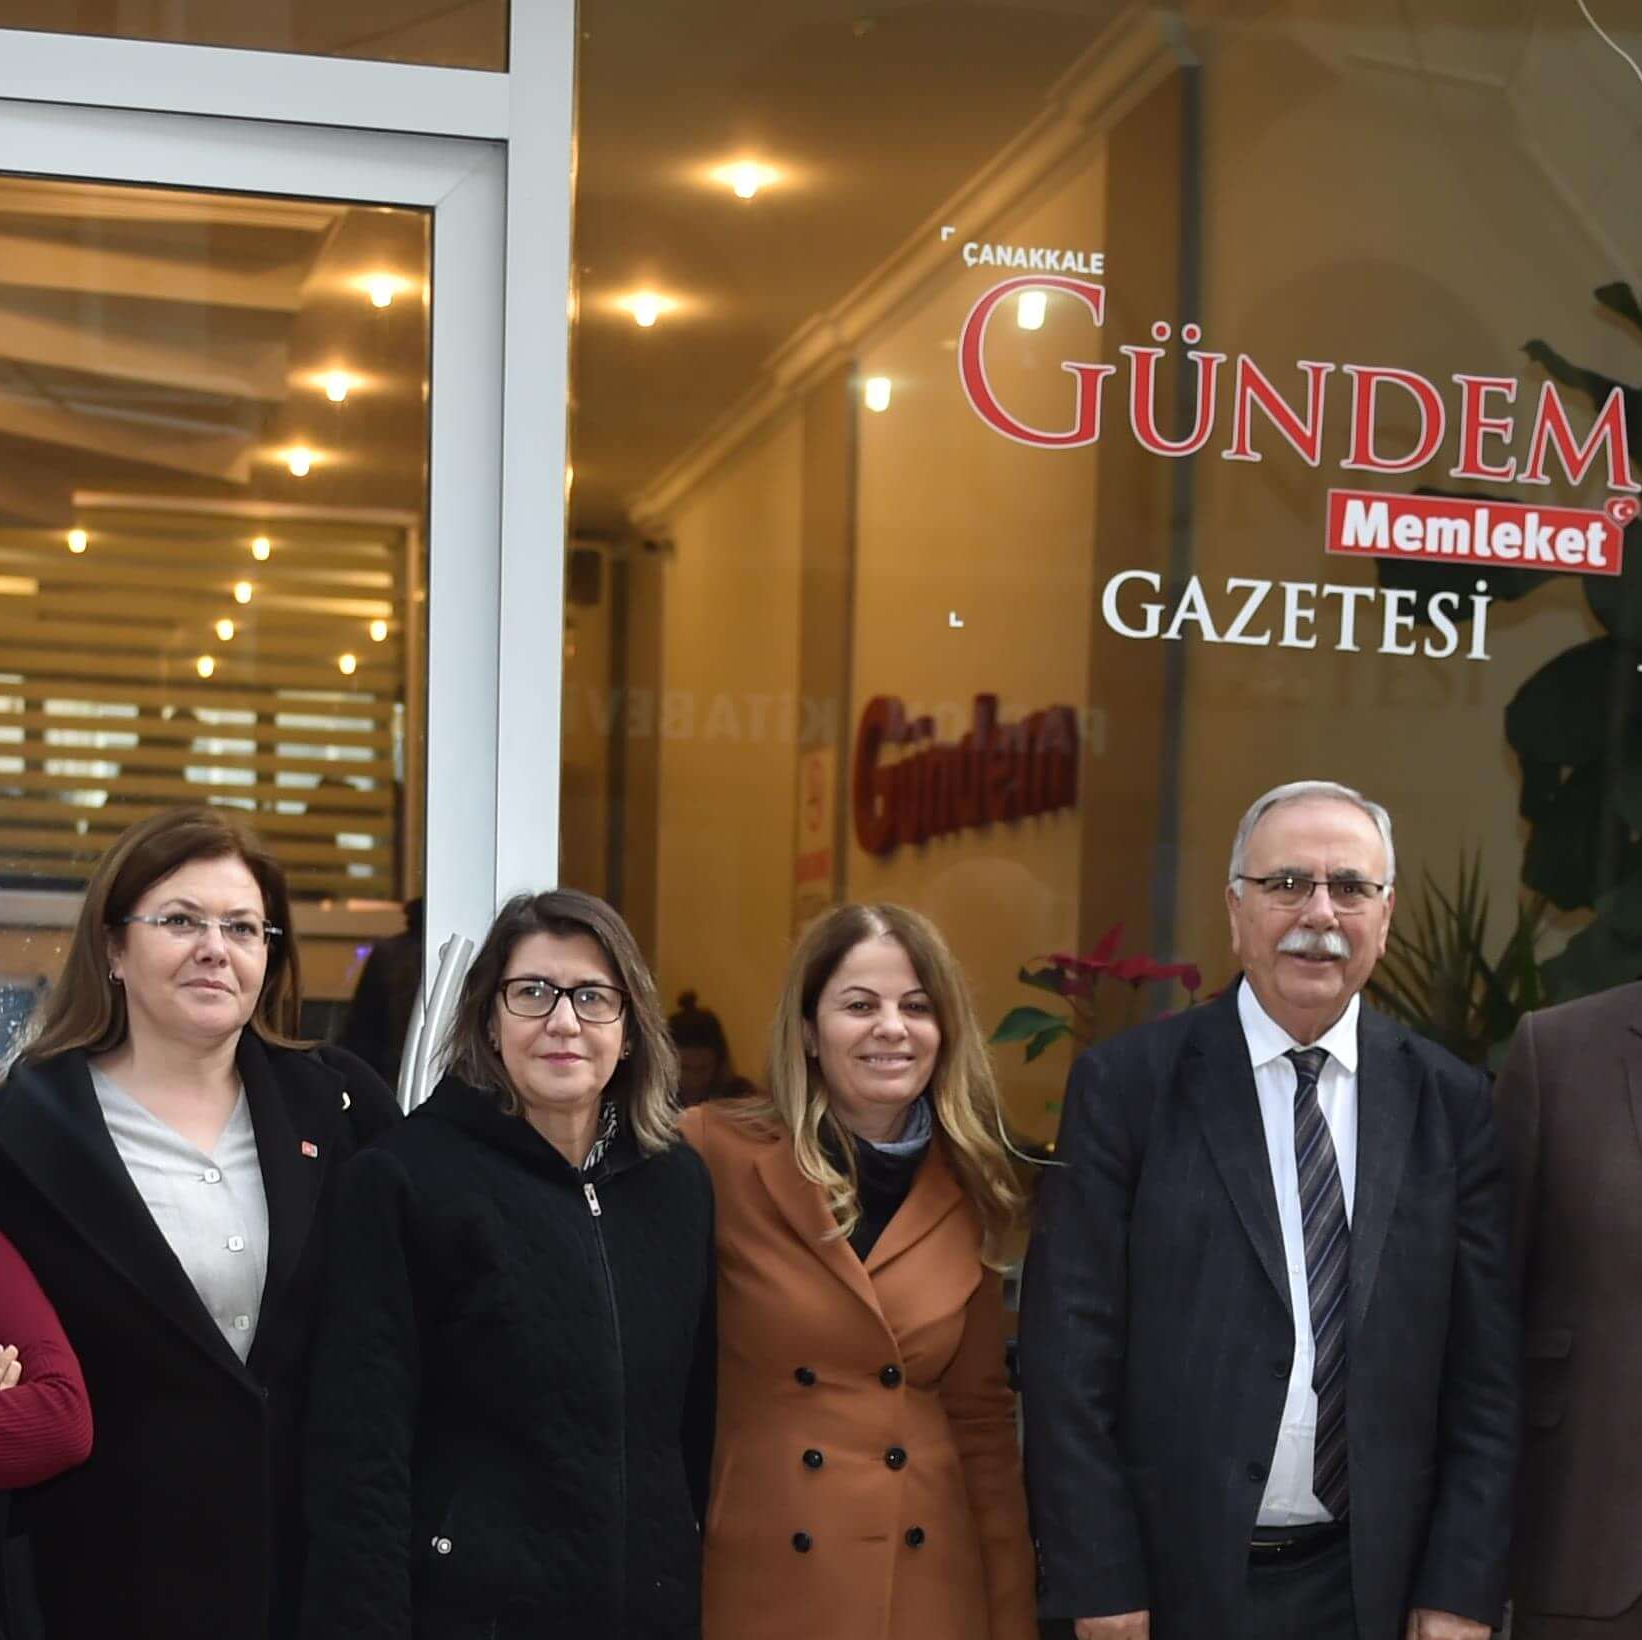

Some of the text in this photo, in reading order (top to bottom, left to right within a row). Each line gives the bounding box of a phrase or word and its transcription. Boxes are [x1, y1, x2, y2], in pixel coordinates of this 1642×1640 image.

[962, 242, 1105, 275] ÇANAKKALE
[957, 275, 1642, 493] GÜNDEM
[1341, 499, 1608, 567] Memleket
[1102, 570, 1493, 661] GAZETESİ
